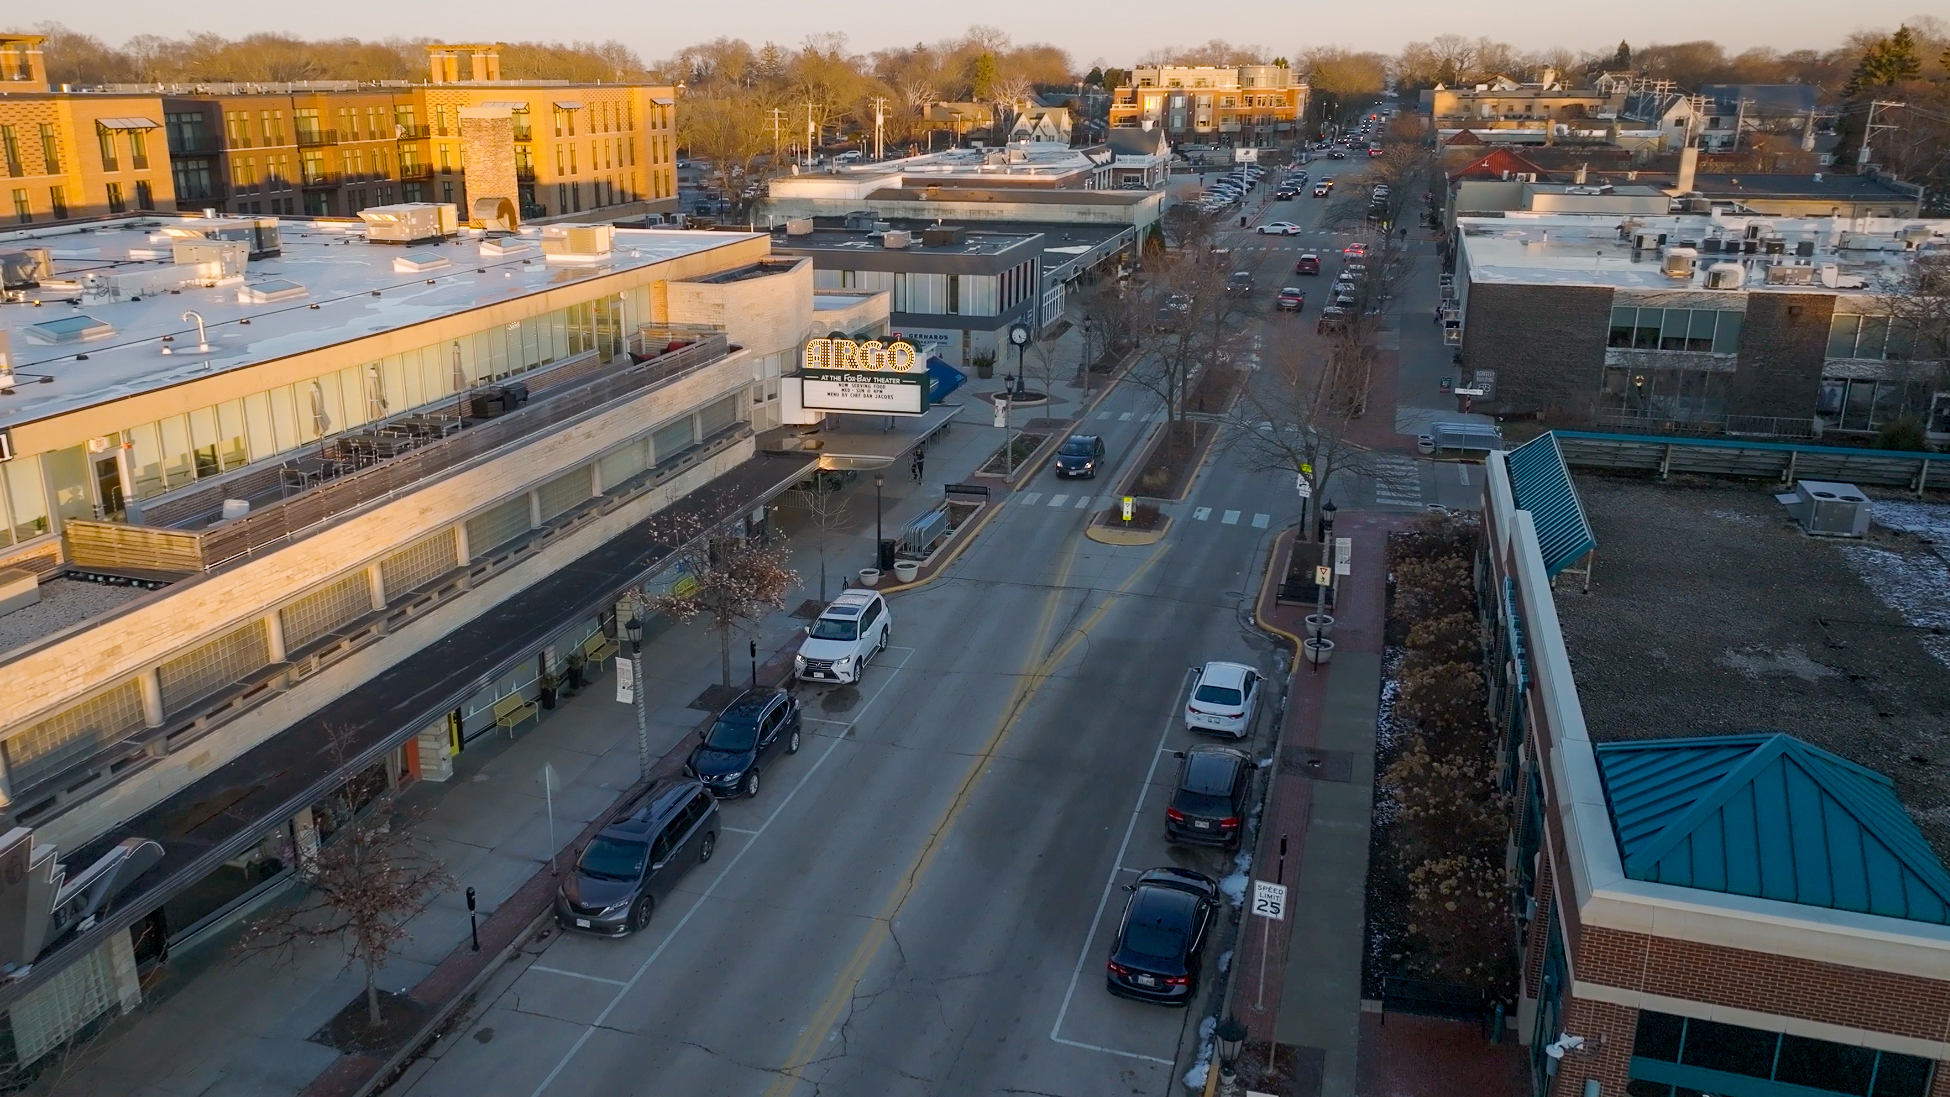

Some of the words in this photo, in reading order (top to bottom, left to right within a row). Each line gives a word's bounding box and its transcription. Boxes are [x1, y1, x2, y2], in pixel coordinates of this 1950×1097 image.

[806, 338, 916, 373] ARGO
[873, 376, 901, 384] THEATER
[1257, 885, 1284, 895] SPEED
[1259, 892, 1281, 901] LIMIT
[1256, 899, 1281, 915] 25
